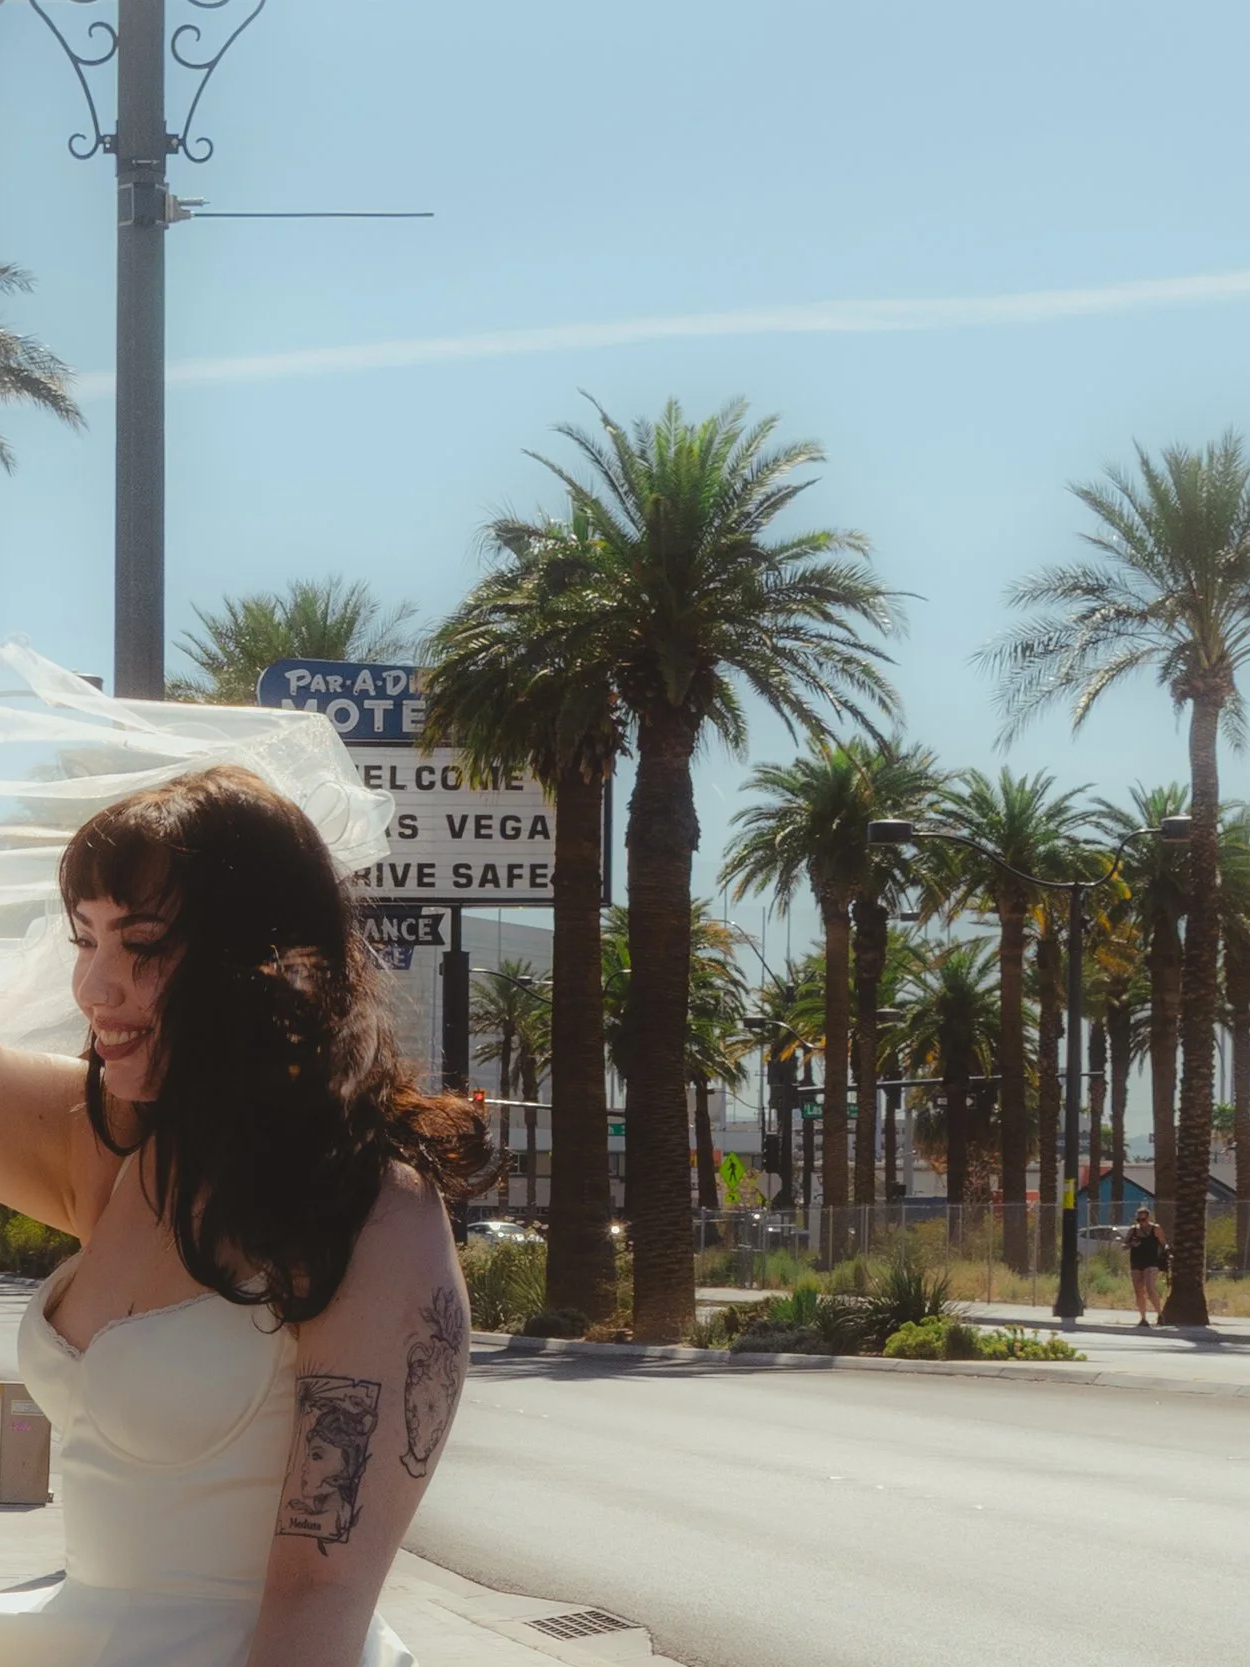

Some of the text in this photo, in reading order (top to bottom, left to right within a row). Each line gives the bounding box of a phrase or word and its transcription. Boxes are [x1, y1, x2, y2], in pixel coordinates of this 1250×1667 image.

[281, 699, 427, 733] OTE
[355, 765, 524, 791] ELCOE
[446, 814, 551, 840] VEGA
[352, 863, 436, 888] RIVE
